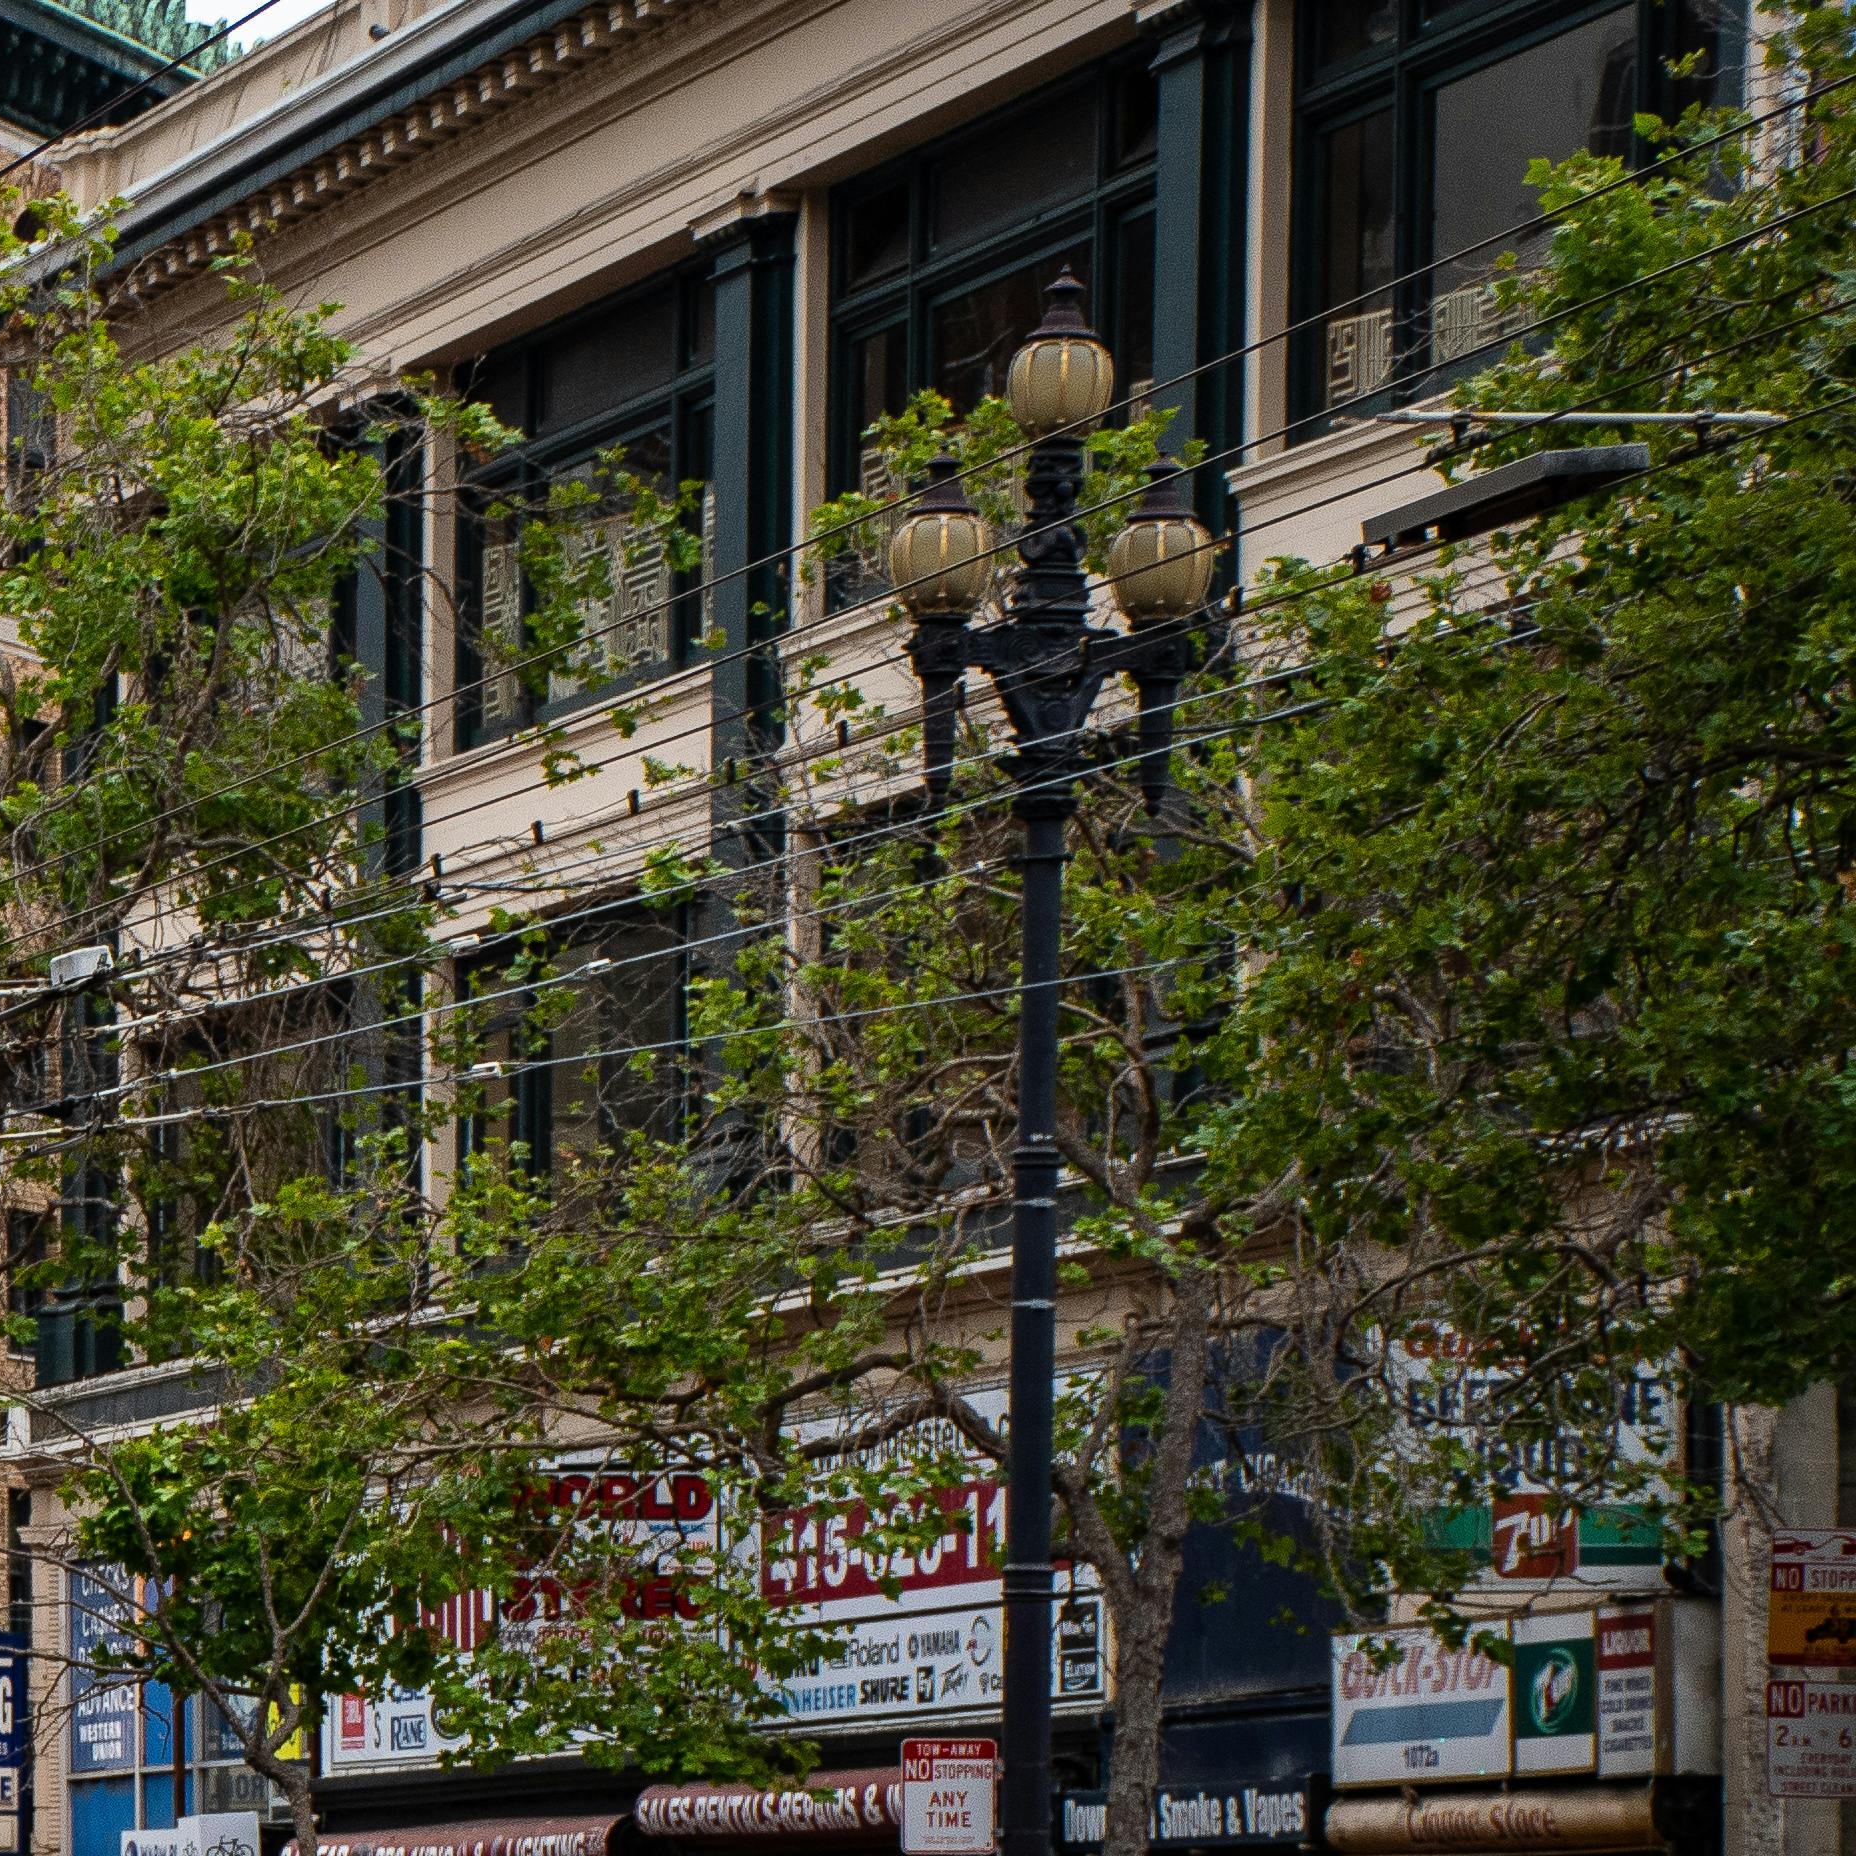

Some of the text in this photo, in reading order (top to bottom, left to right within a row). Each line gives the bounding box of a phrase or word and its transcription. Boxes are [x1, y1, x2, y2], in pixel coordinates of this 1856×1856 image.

[1774, 1567, 1801, 1590] NO
[848, 1633, 900, 1667] Roland
[920, 1628, 960, 1656] YAMAHA
[1602, 1627, 1651, 1657] LIQUOR
[772, 1682, 857, 1713] NNHEISER
[859, 1674, 912, 1705] SHURE
[1770, 1684, 1803, 1714] NO
[79, 1720, 122, 1743] WESTERN
[92, 1740, 122, 1761] UNION
[916, 1743, 983, 1757] TOW-AWAY
[904, 1758, 993, 1781] NO STOPPING
[865, 1782, 883, 1825] &
[928, 1790, 969, 1808] ANY
[926, 1811, 972, 1828] TIME
[1161, 1792, 1223, 1841] Smoke
[1226, 1796, 1241, 1836] &
[1244, 1788, 1305, 1839] Vapes
